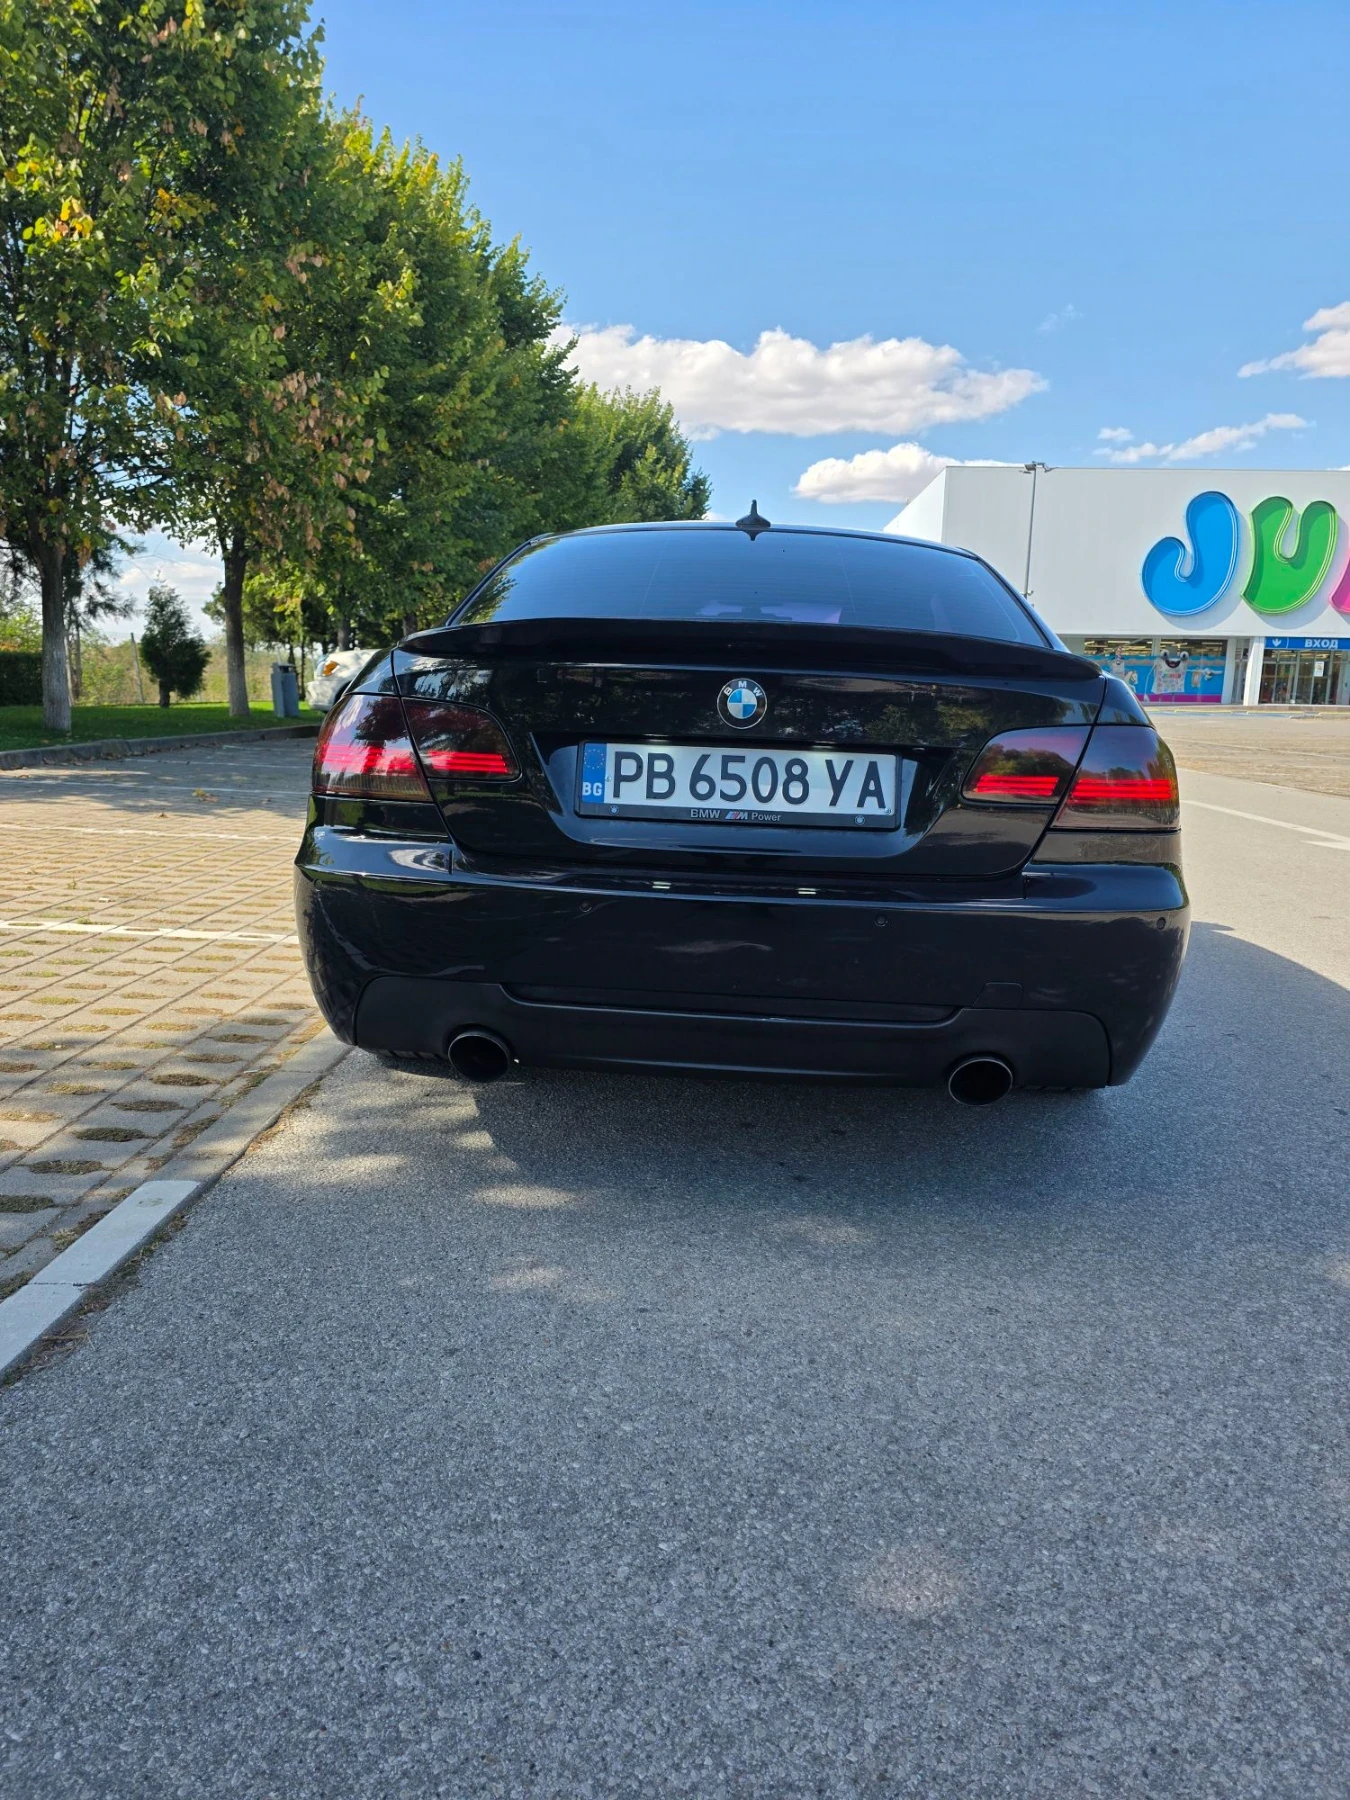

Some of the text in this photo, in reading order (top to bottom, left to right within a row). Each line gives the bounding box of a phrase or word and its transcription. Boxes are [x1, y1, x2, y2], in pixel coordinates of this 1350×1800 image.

[1140, 490, 1350, 616] JU
[1304, 639, 1339, 650] ВХОД
[723, 680, 763, 697] BMW
[613, 751, 886, 809] PB 6508 YA
[582, 782, 603, 796] BG
[690, 808, 720, 819] BMW
[751, 812, 781, 822] Power
